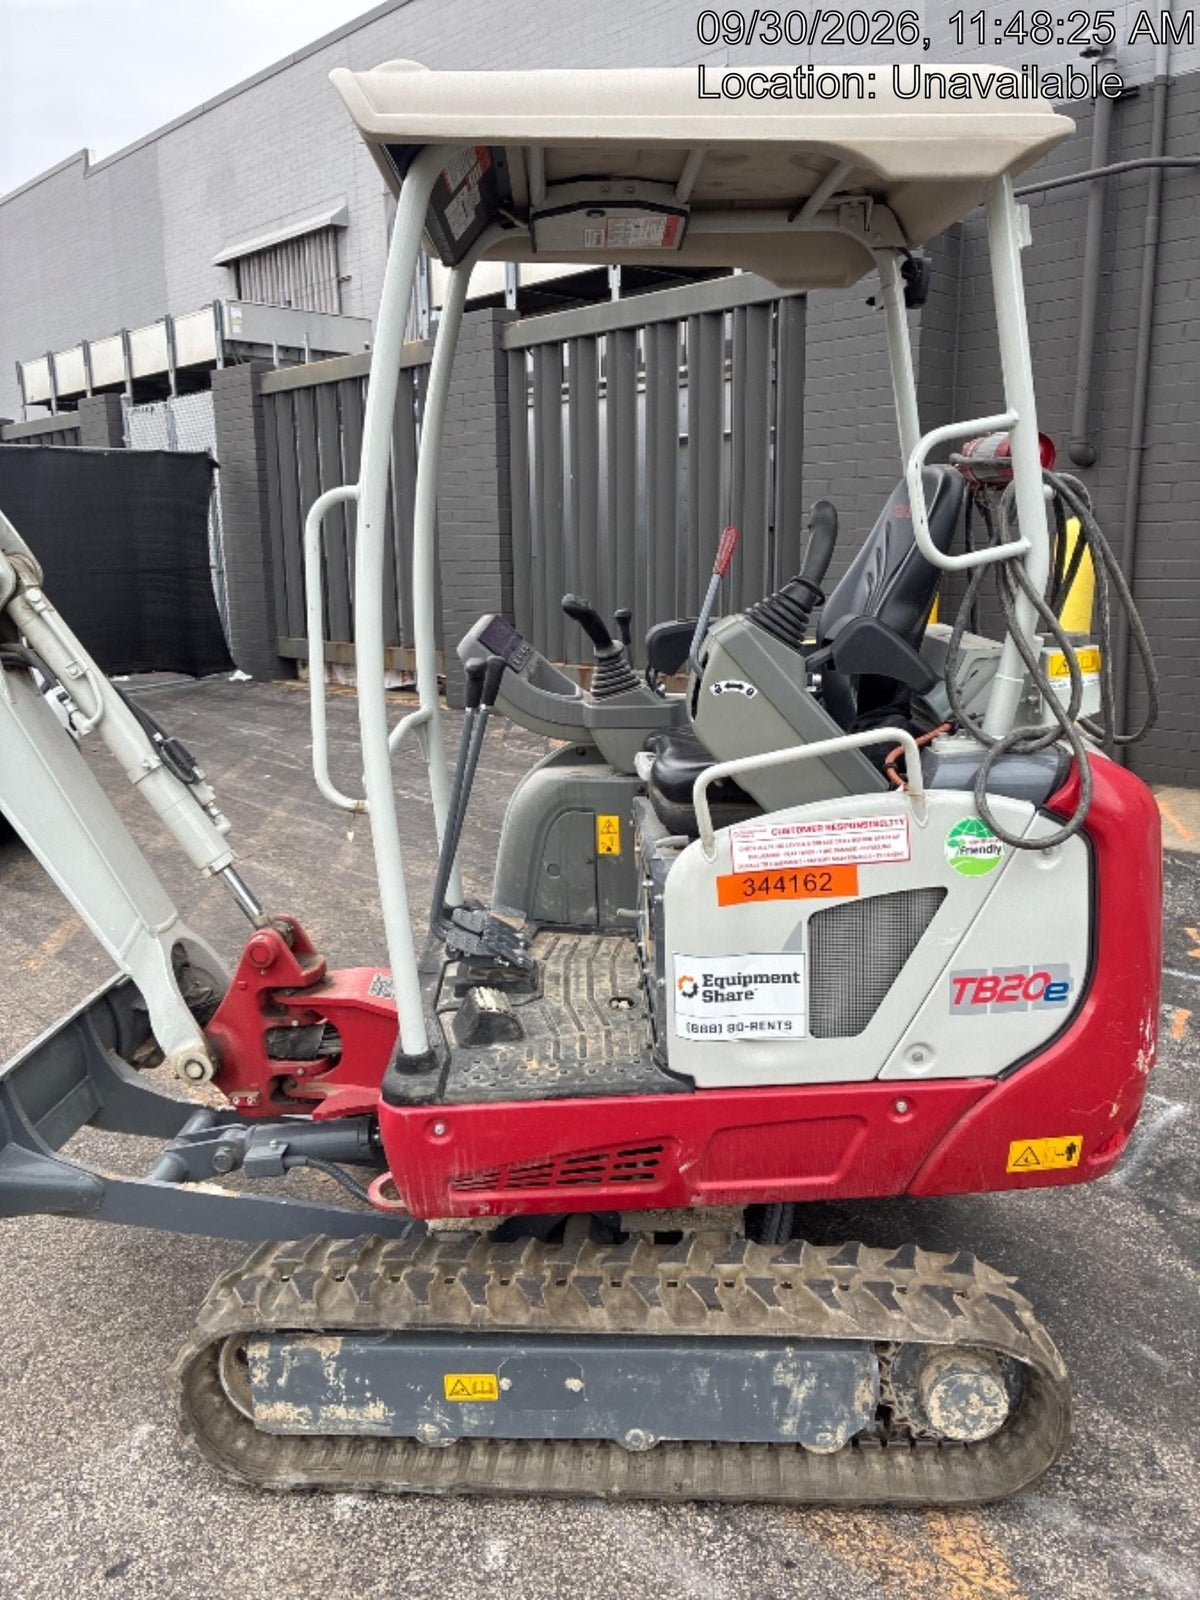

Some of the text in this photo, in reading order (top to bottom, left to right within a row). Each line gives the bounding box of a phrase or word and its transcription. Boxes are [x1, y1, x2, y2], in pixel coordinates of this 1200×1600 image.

[771, 824, 823, 836] CUSTOMER
[742, 872, 833, 897] 344162
[702, 971, 801, 989] Equipment
[952, 972, 1068, 1005] TB20e
[686, 1020, 792, 1034] (888) 80-RENTS
